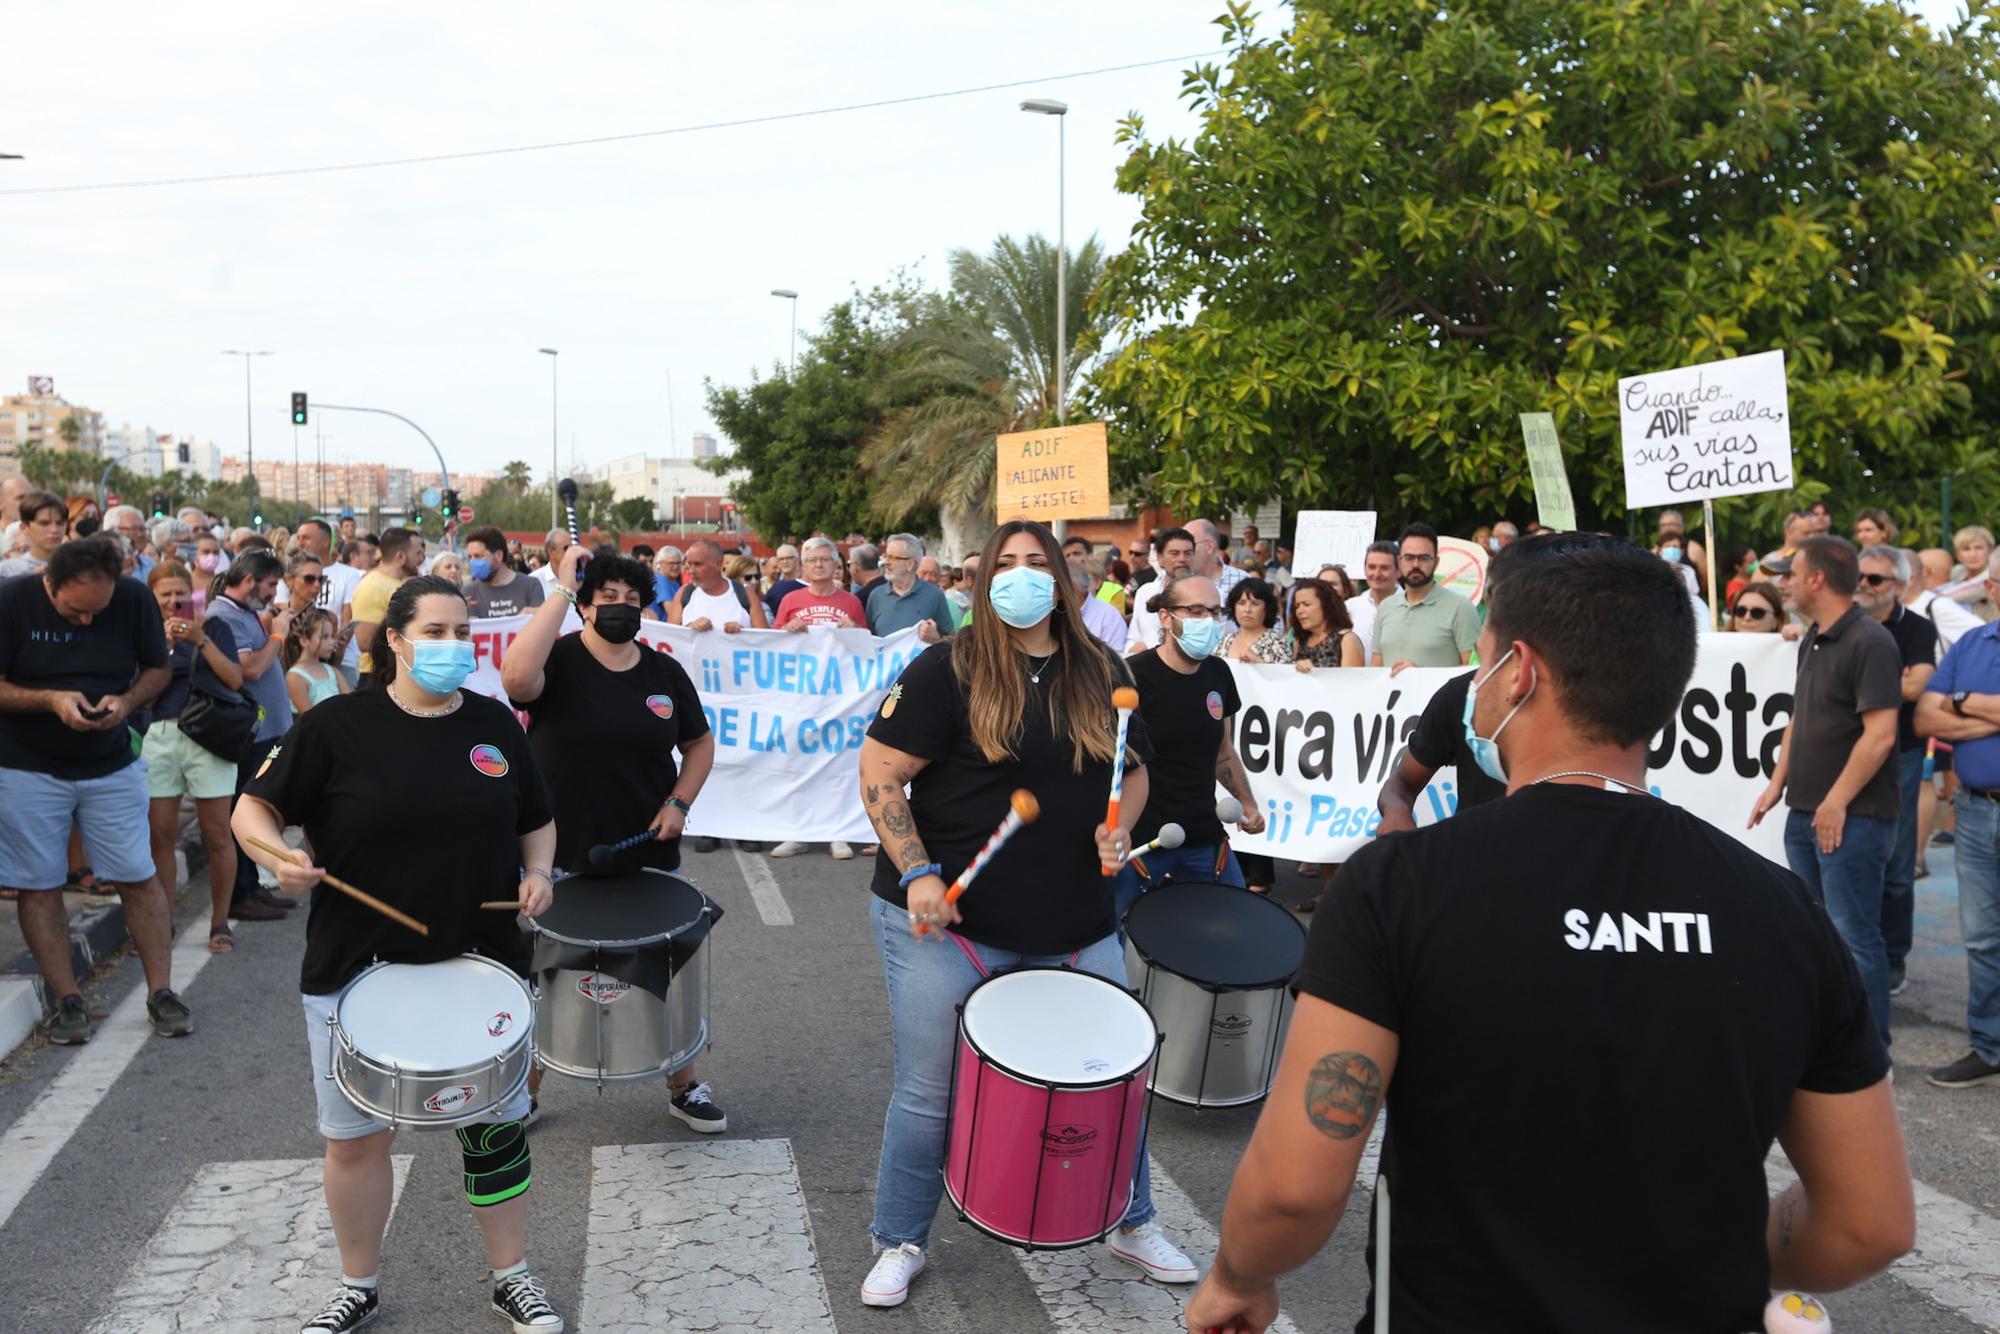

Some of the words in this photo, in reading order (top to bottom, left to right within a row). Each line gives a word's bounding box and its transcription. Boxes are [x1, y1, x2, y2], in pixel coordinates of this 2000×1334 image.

[1645, 406, 1700, 439] ADIF
[1709, 400, 1784, 423] calla,
[1633, 444, 1680, 466] sus
[1665, 456, 1789, 493] Cantan
[809, 605, 836, 615] TEMPLE
[732, 649, 844, 697] FUERA
[749, 711, 788, 754] LA
[796, 710, 876, 755] COS
[1305, 794, 1381, 839] Pase
[1563, 908, 1713, 954] SANTI
